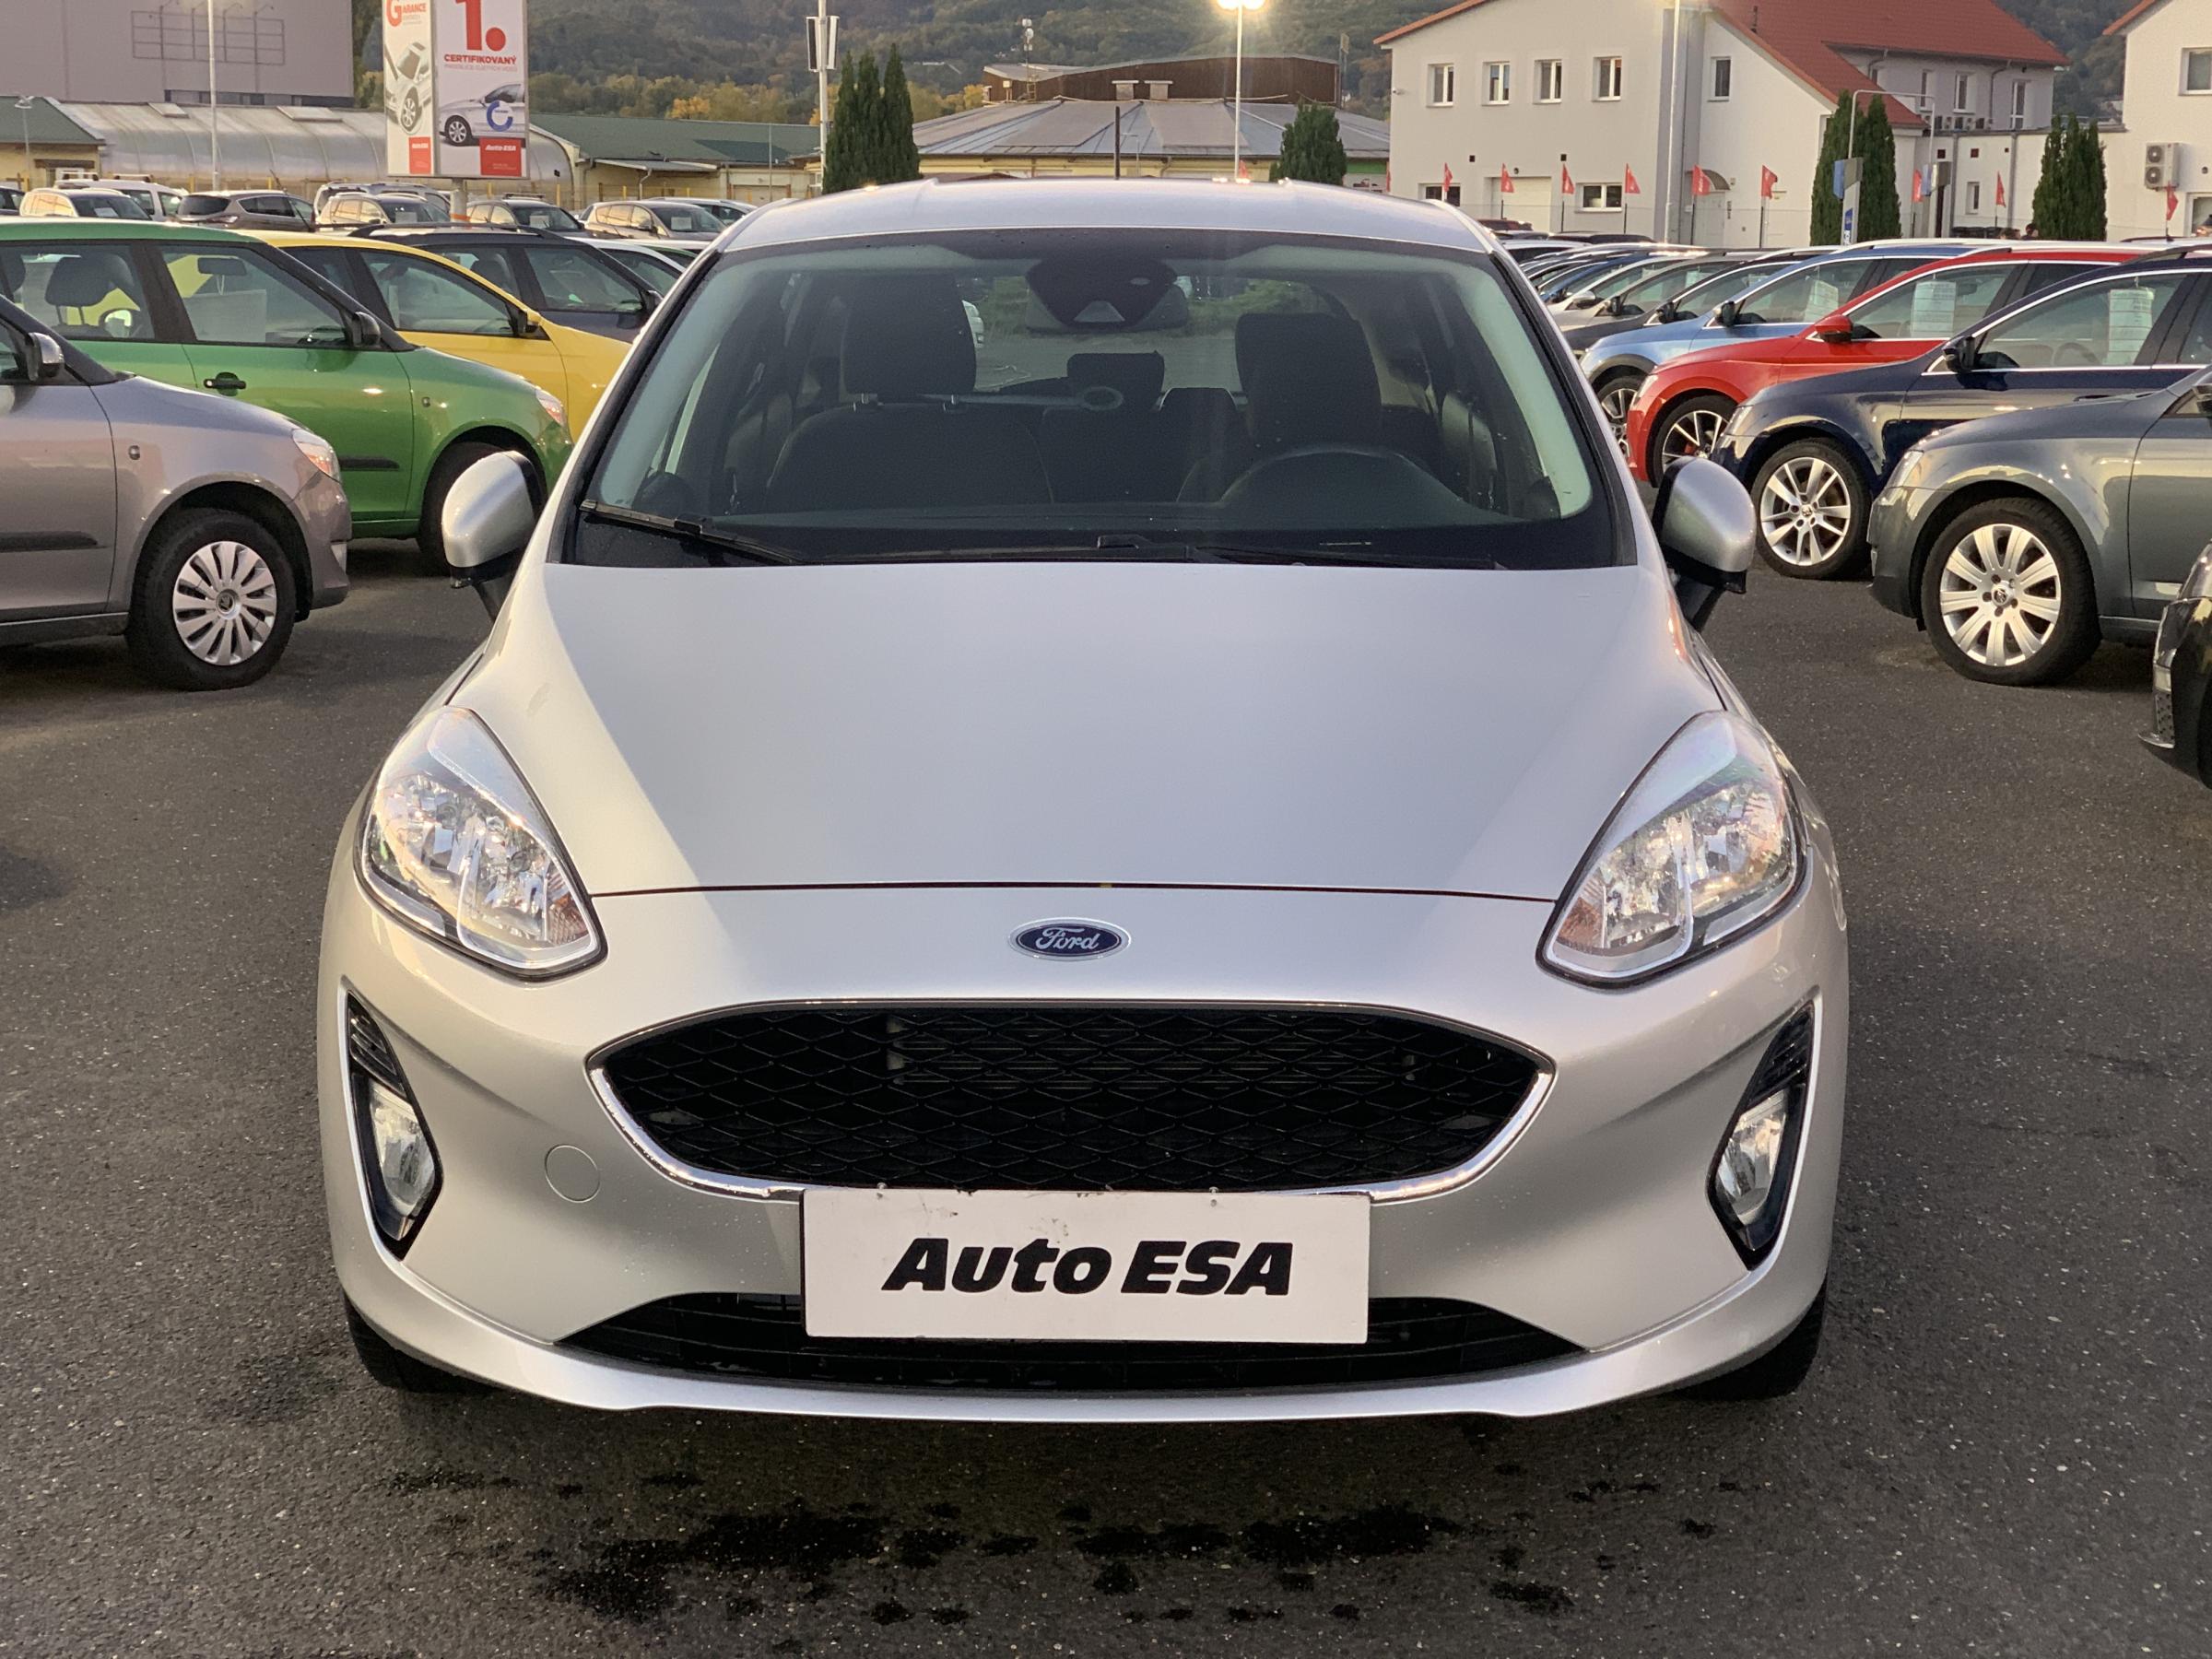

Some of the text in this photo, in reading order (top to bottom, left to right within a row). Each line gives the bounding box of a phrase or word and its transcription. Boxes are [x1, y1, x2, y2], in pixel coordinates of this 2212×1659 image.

[443, 53, 517, 65] CERTIFIKOVANÝ
[1035, 926, 1101, 949] Ford
[881, 1237, 1293, 1297] Auto ESA
